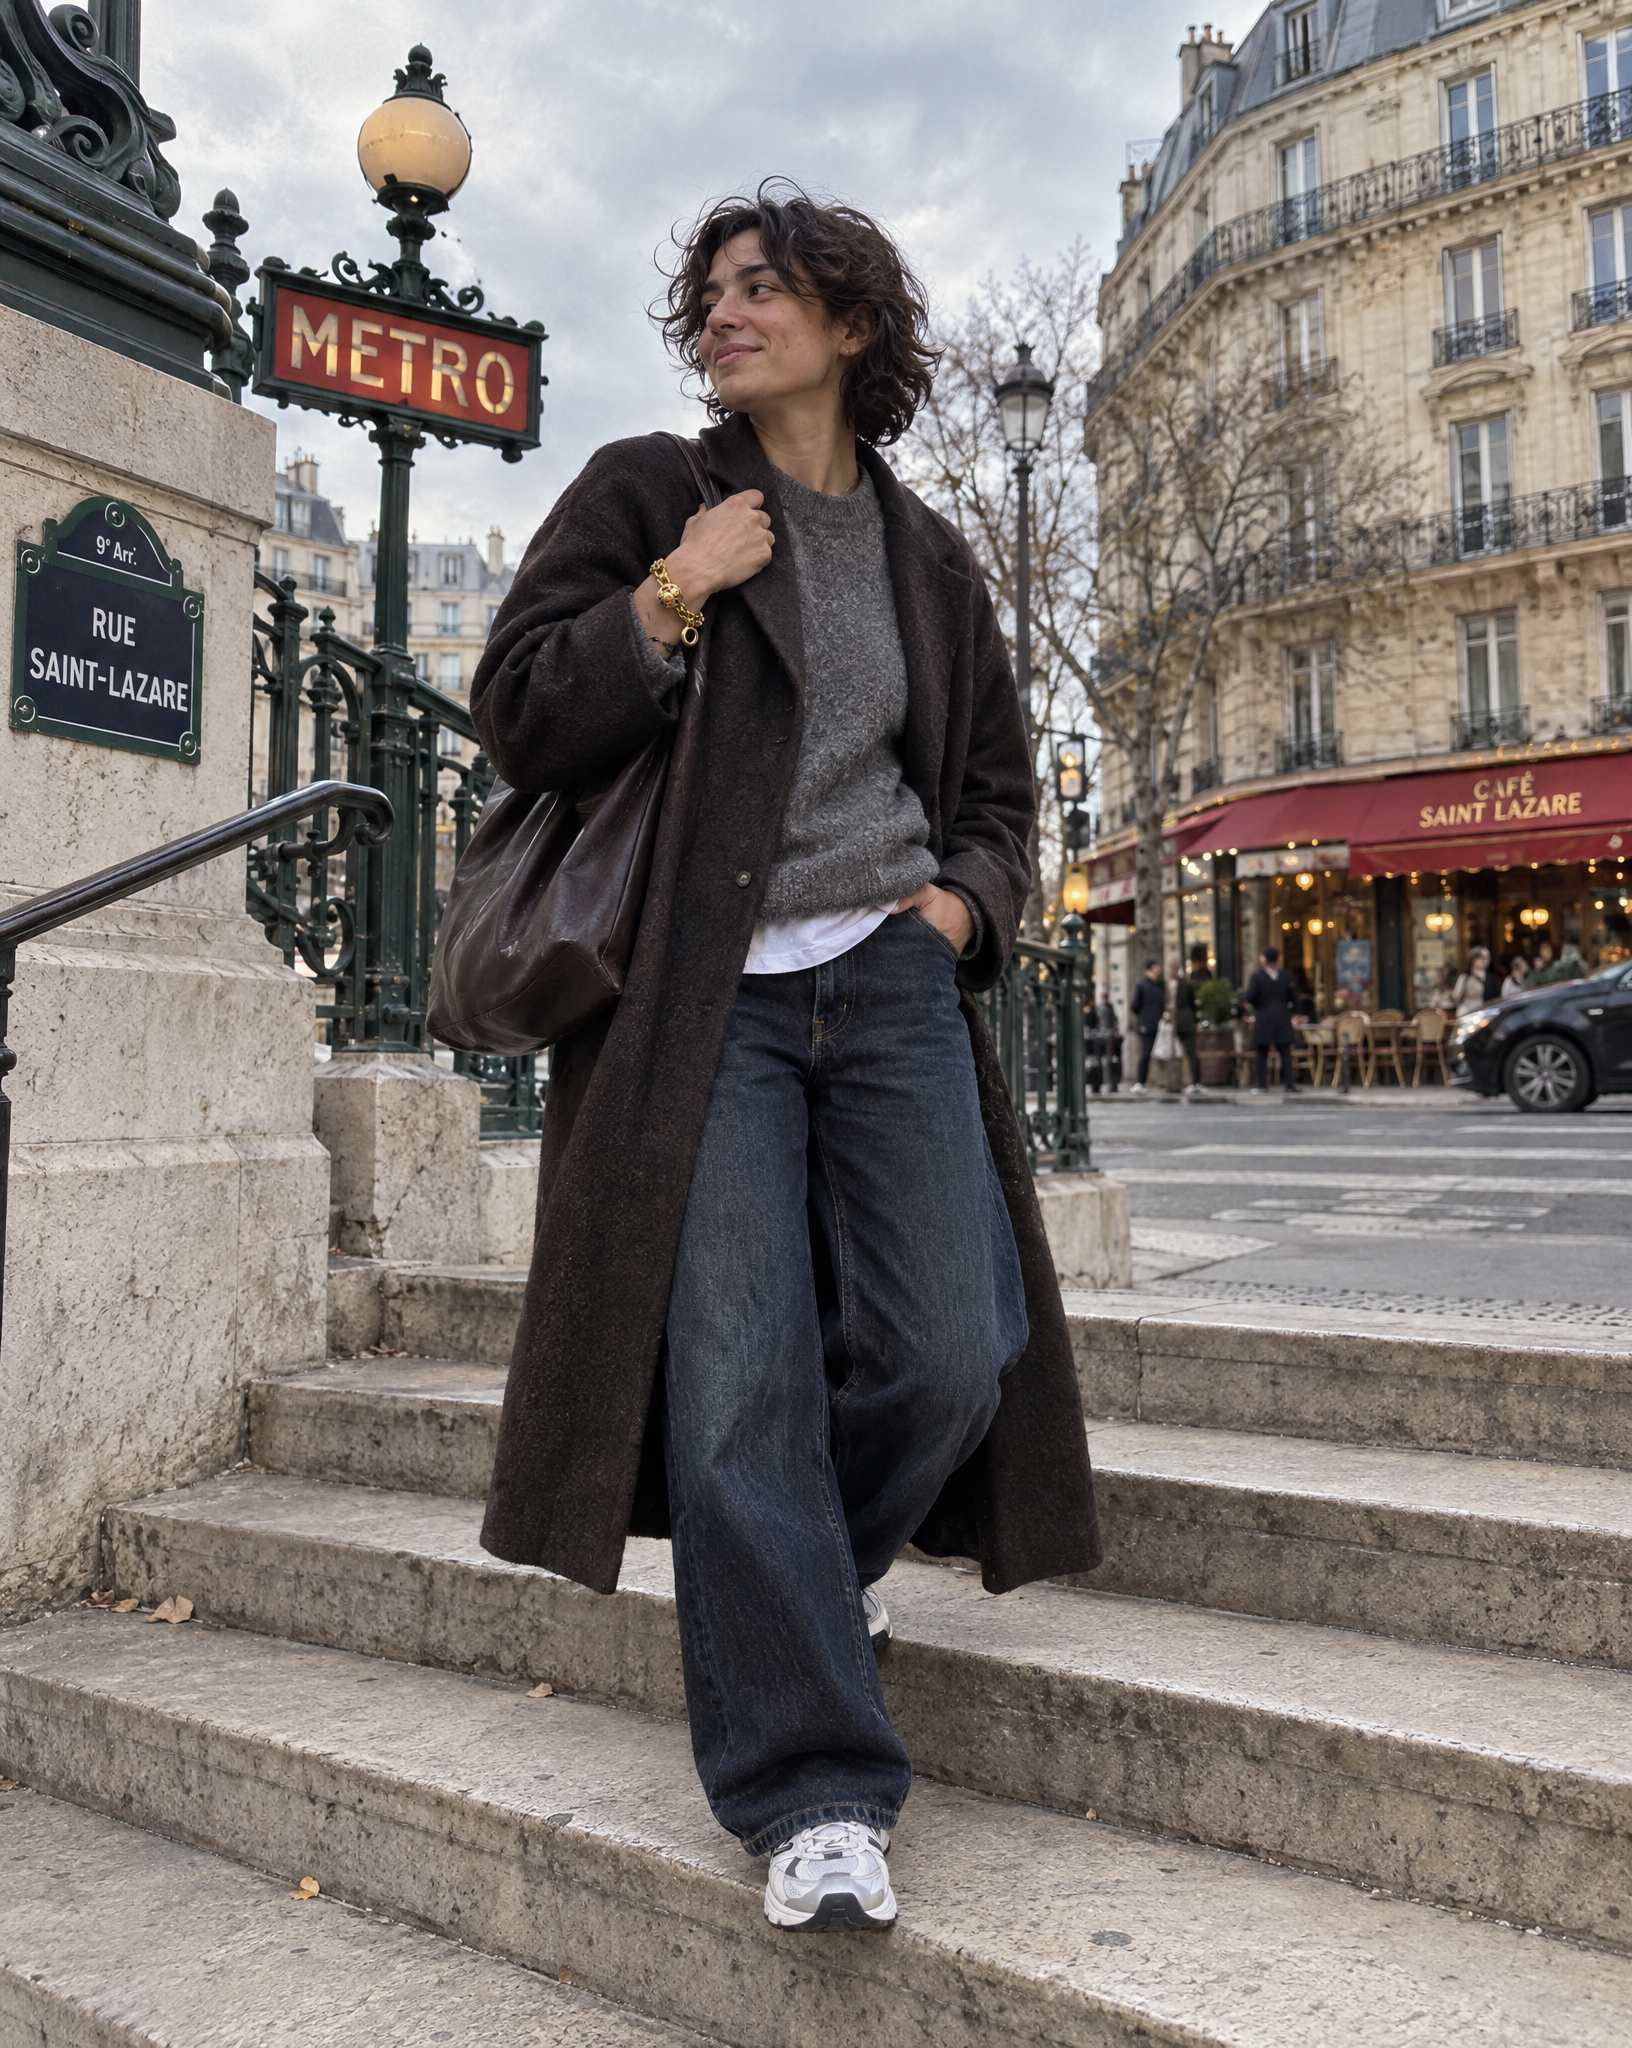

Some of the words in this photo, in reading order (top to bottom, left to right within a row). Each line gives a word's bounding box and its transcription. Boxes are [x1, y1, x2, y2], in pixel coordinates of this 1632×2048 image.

[291, 305, 514, 414] METRO
[92, 607, 136, 647] RUE
[30, 647, 188, 712] SAINT-LAZARE
[1474, 771, 1534, 800] CAFÉ
[1419, 802, 1487, 828] SAINT
[1494, 792, 1582, 821] LAZARE
